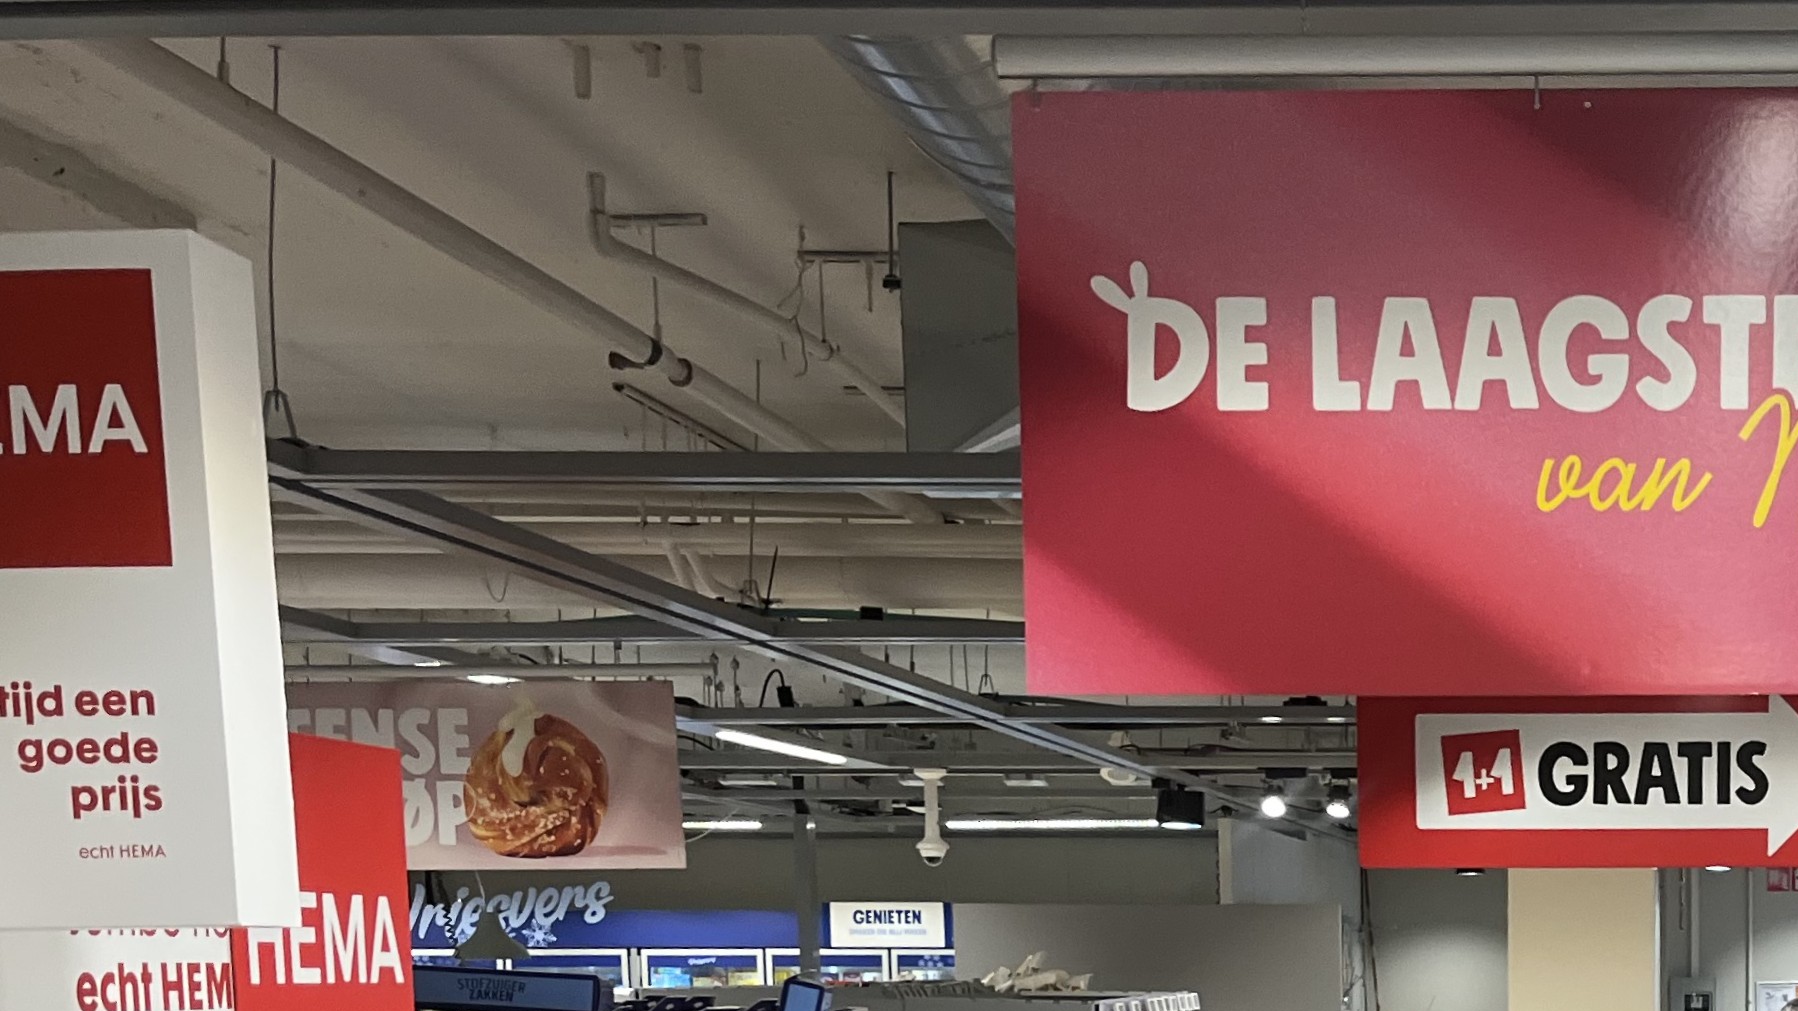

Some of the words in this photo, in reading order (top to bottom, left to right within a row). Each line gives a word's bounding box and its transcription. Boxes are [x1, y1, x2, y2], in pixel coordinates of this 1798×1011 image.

[1122, 291, 1270, 414] DE
[0, 384, 148, 455] MA
[1535, 450, 1712, 514] van
[75, 688, 156, 718] een
[17, 731, 159, 773] goede
[1452, 747, 1515, 799] 1+1
[1537, 740, 1770, 808] GRATIS
[71, 775, 164, 819] prijs
[78, 845, 115, 860] echt
[119, 844, 167, 859] HEMA
[853, 908, 922, 925] GENIETEN
